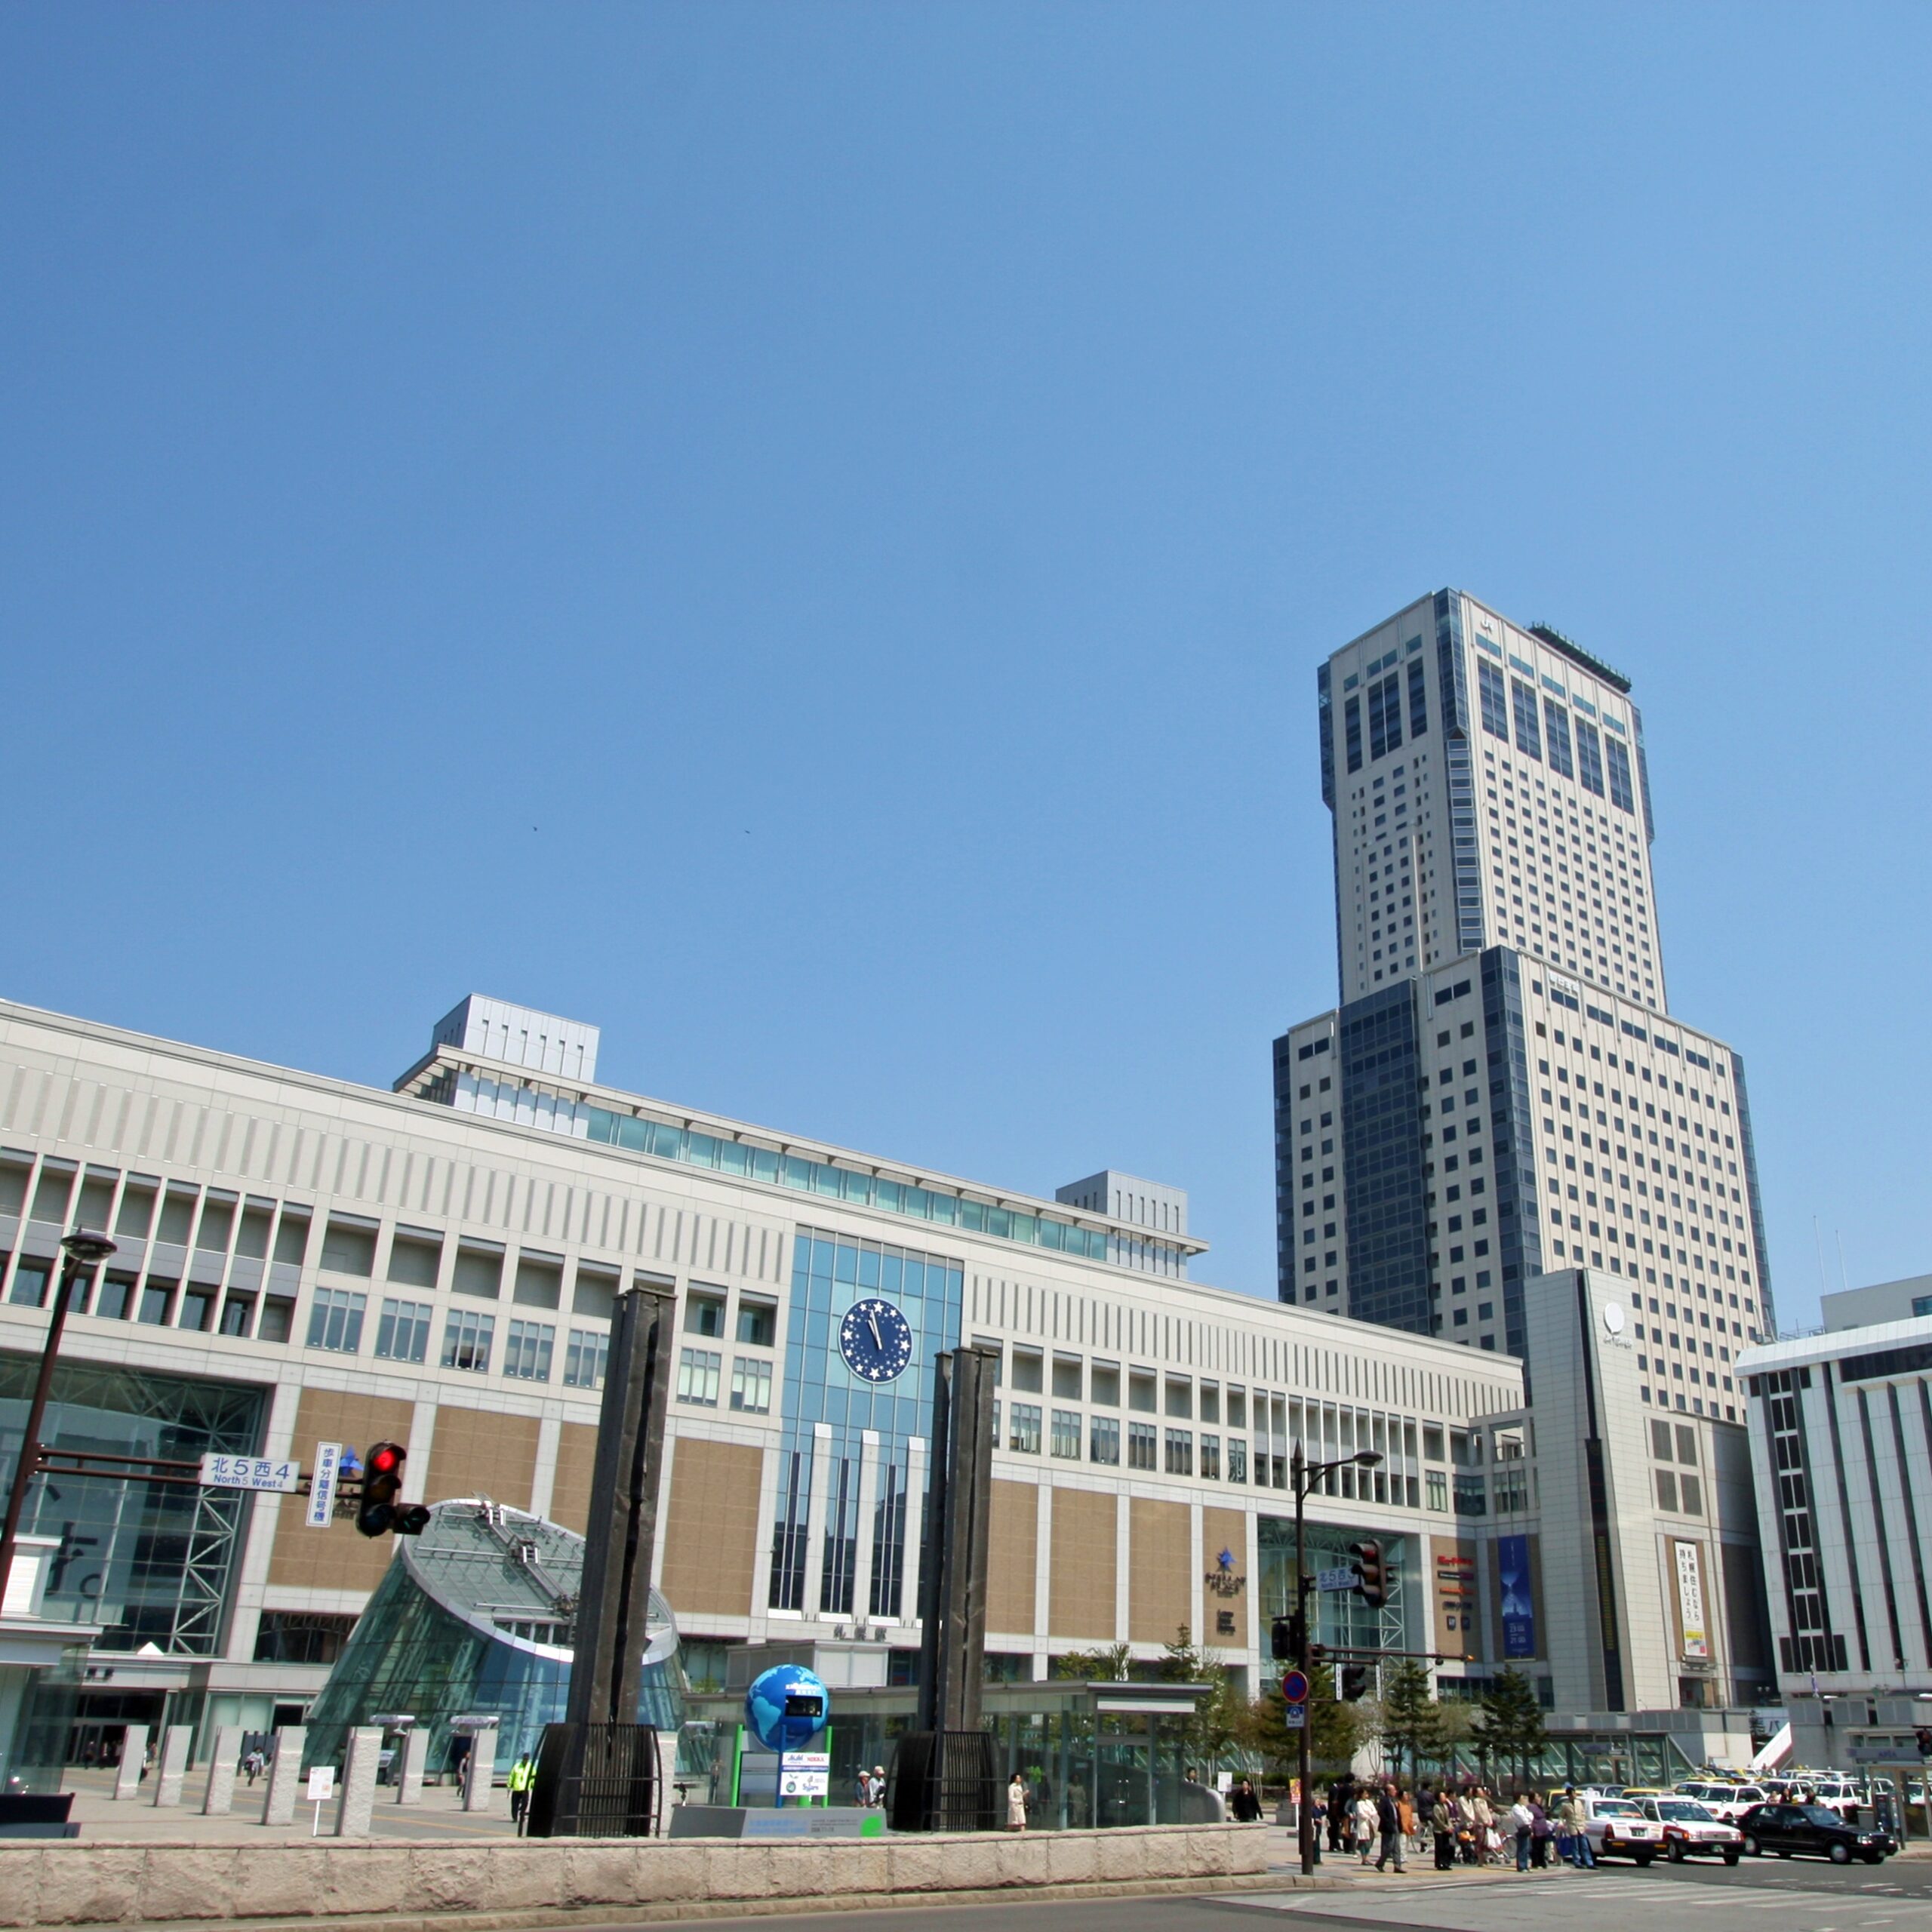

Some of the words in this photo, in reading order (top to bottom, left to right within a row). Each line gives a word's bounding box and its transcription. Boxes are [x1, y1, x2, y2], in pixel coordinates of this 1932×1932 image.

[211, 1457, 290, 1479] 北5西4
[313, 1447, 334, 1522] 歩車分離信号機
